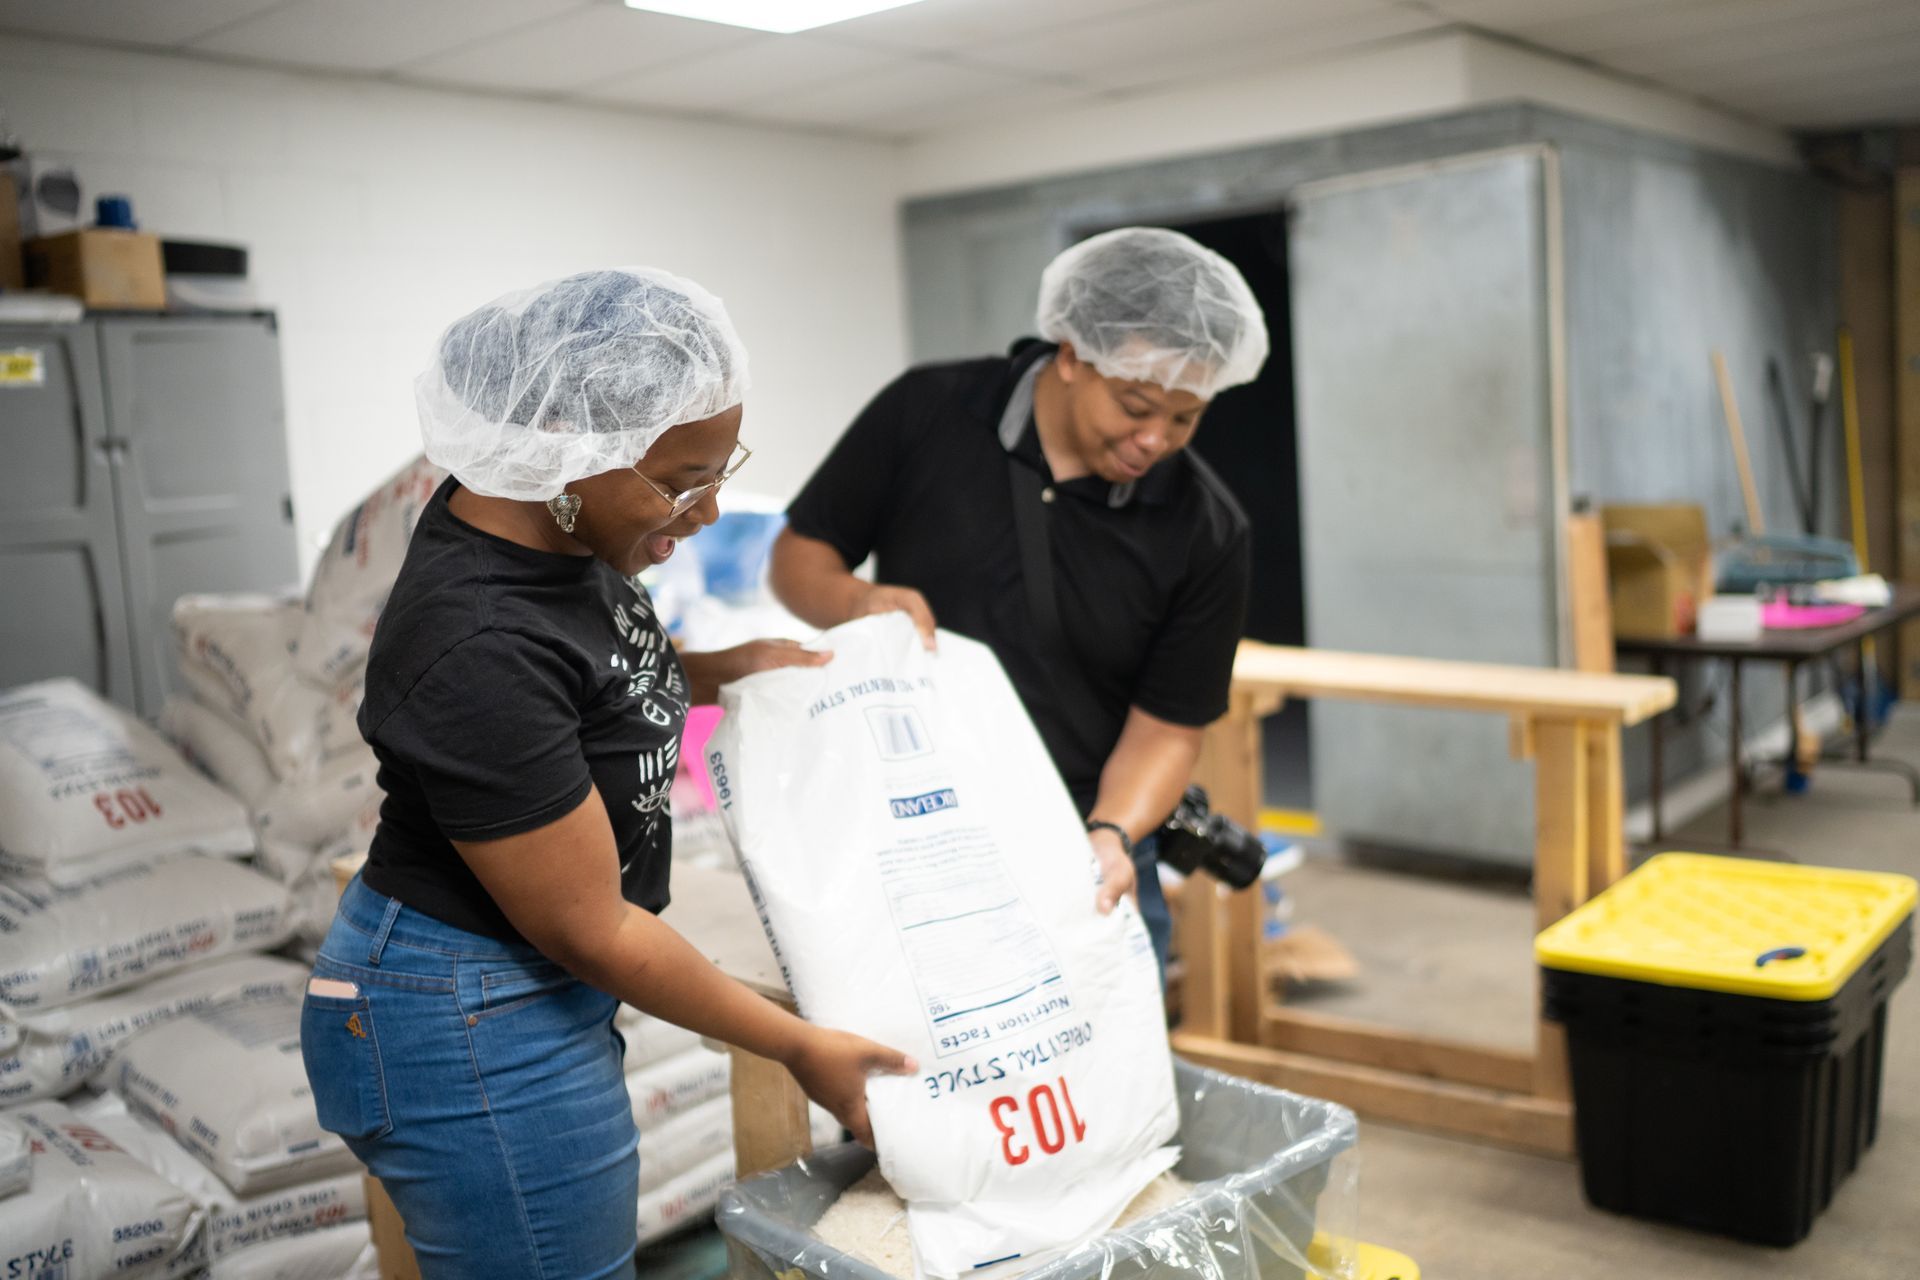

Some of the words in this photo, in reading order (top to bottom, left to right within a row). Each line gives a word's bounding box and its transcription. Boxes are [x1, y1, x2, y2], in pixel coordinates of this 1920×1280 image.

[709, 751, 733, 811] 19633
[92, 784, 163, 829] 103
[929, 1003, 951, 1016] 160
[996, 994, 1071, 1032] Nutrition
[940, 1025, 991, 1049] Facts
[924, 1057, 1006, 1099] STYLE
[989, 1075, 1087, 1166] 103
[112, 1218, 164, 1244] 35200
[6, 1238, 74, 1280] STYLE
